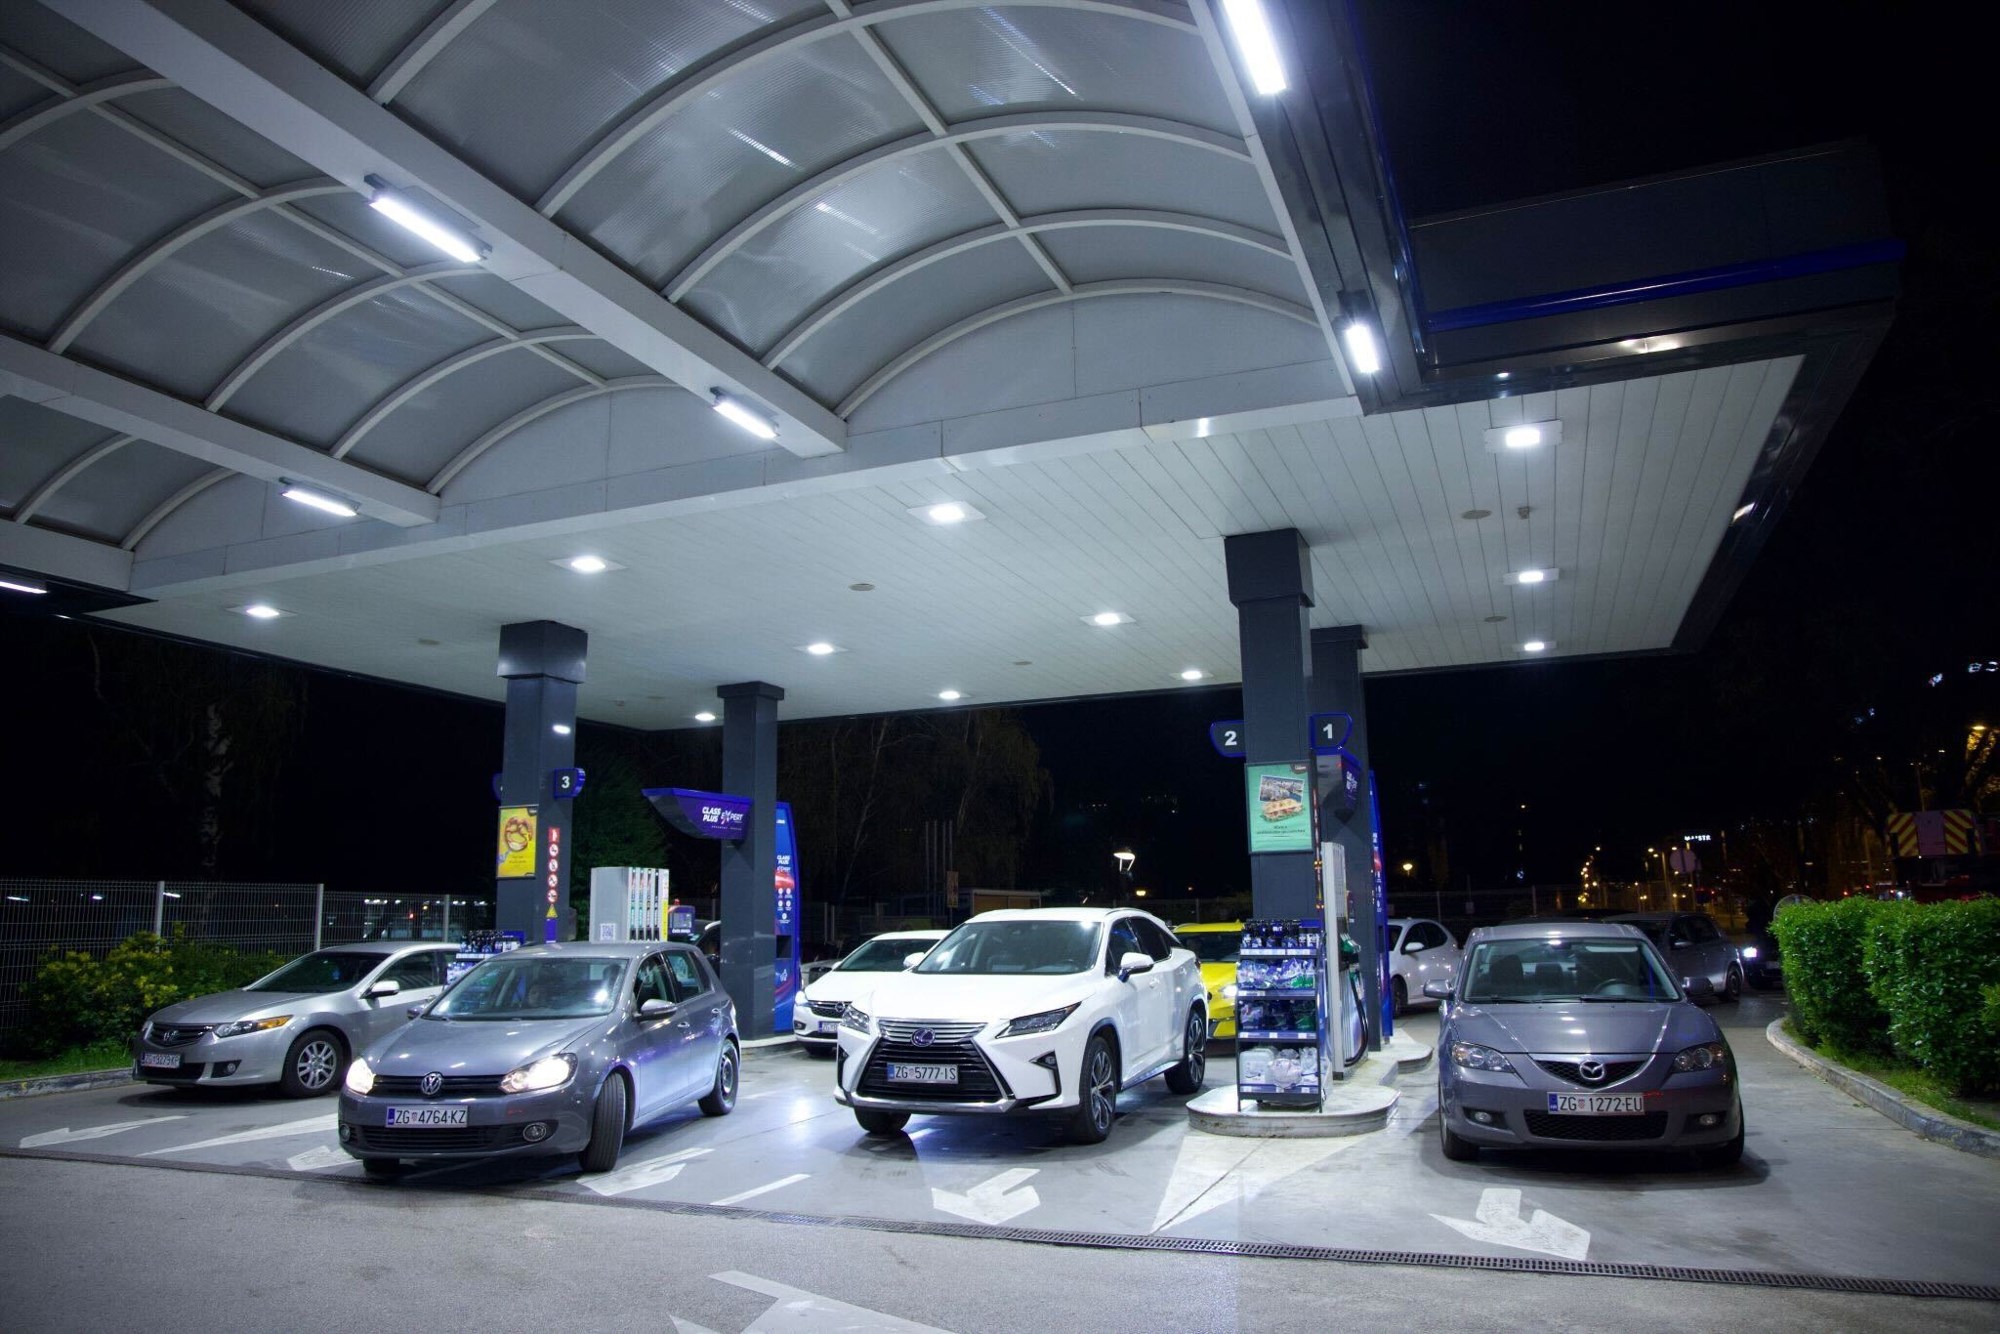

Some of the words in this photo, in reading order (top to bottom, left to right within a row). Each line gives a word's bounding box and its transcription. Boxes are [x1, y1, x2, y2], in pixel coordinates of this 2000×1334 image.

[1323, 723, 1333, 739] 1
[1224, 730, 1238, 746] 2
[561, 776, 570, 789] 3
[702, 806, 721, 816] CLASS
[702, 814, 719, 823] PLUS
[895, 1066, 908, 1079] ZG
[1559, 1096, 1577, 1111] ZG
[395, 1110, 410, 1124] ZG
